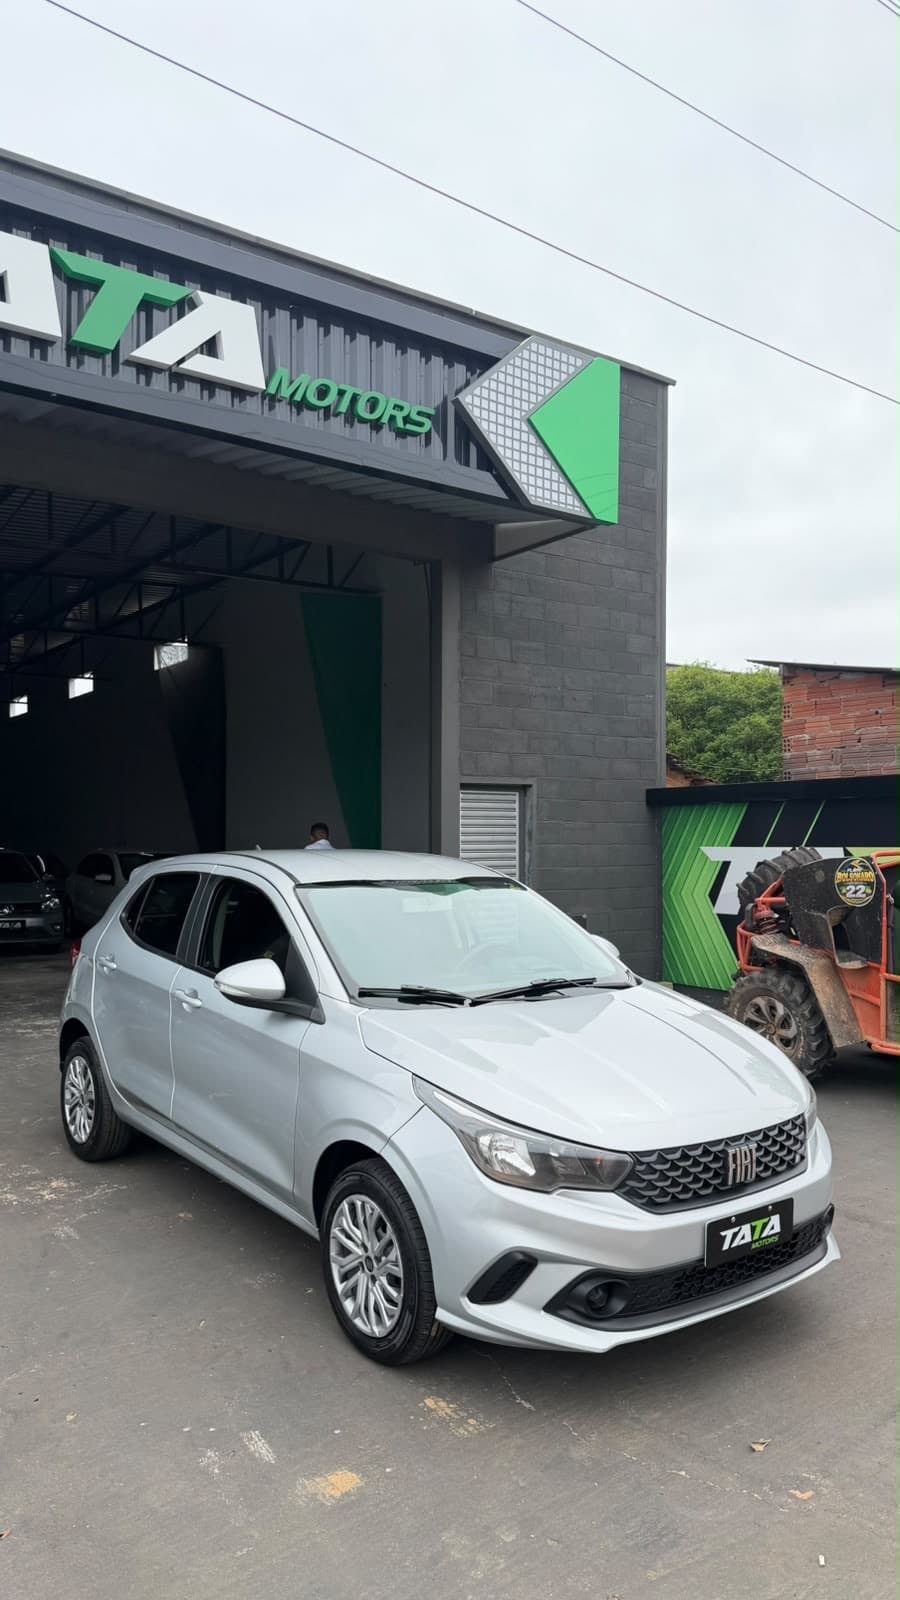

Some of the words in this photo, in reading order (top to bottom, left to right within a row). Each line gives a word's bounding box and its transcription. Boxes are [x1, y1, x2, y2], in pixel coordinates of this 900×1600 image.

[266, 367, 436, 434] MOTORS
[846, 885, 867, 898] 22
[728, 1143, 757, 1185] FIAT
[720, 1214, 781, 1250] TATA
